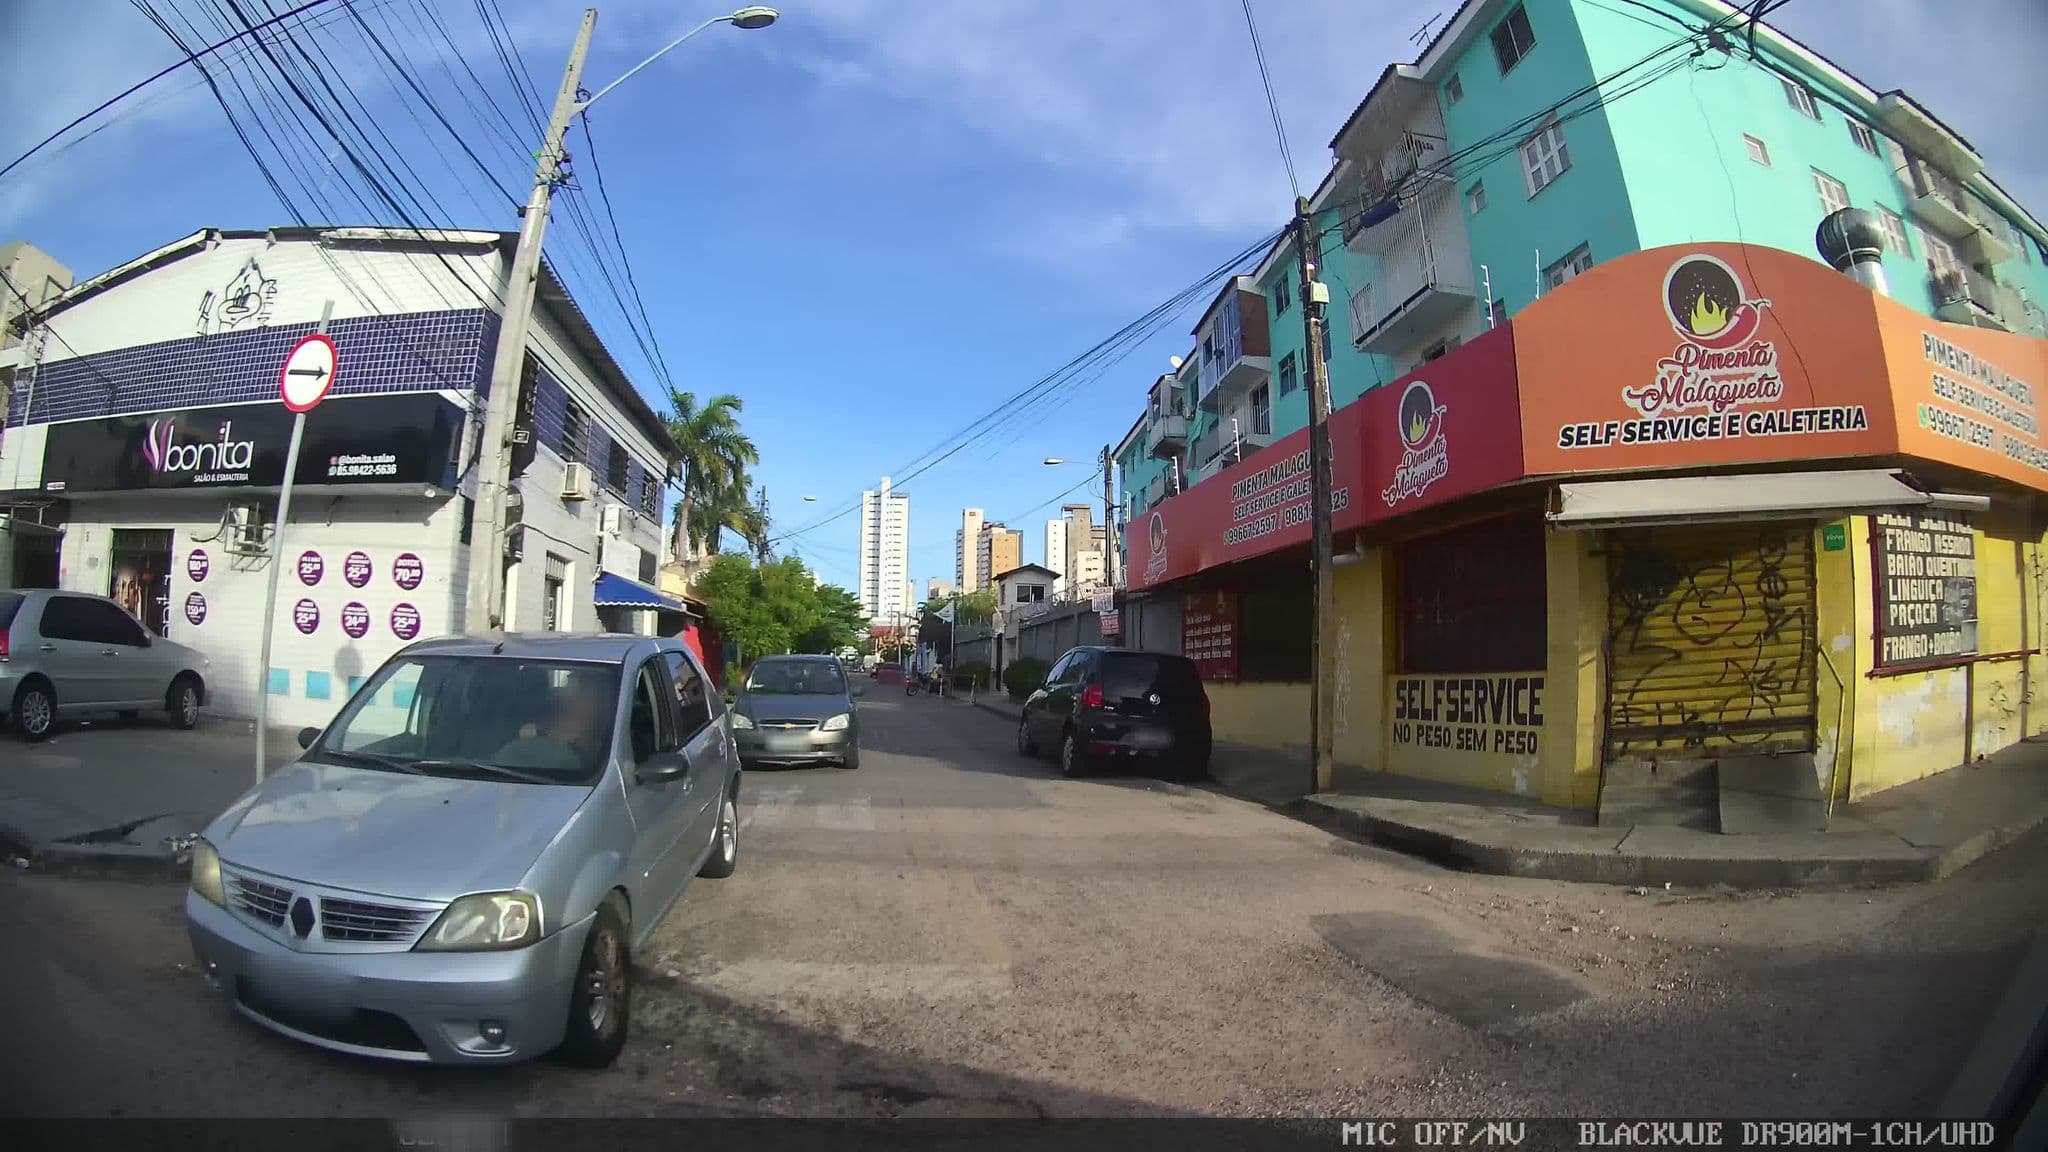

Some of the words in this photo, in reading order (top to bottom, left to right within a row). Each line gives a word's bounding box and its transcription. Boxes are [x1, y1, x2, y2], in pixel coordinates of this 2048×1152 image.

[1659, 342, 1773, 376] Pimenta
[1627, 375, 1782, 413] Malagueta
[1559, 423, 1617, 448] SELF
[1622, 416, 1721, 442] SERVICE
[1727, 414, 1741, 435] E
[1745, 407, 1868, 435] GALETERIA
[164, 421, 254, 472] bonita
[1397, 435, 1447, 475] Pimenta
[1232, 468, 1268, 501] PIMENTA
[1382, 458, 1448, 503] Malagueta
[1233, 503, 1250, 521] SELF
[1250, 488, 1280, 515] SERVICE
[1279, 486, 1287, 504] E
[1886, 528, 1931, 553] FRANGO
[1887, 553, 1924, 576] BAIÃO
[1888, 578, 1943, 601] LINGUIÇA
[1890, 603, 1938, 628] PAÇOCA
[1393, 723, 1411, 744] NO
[1456, 727, 1487, 751] SEM
[1494, 729, 1538, 755] PESO
